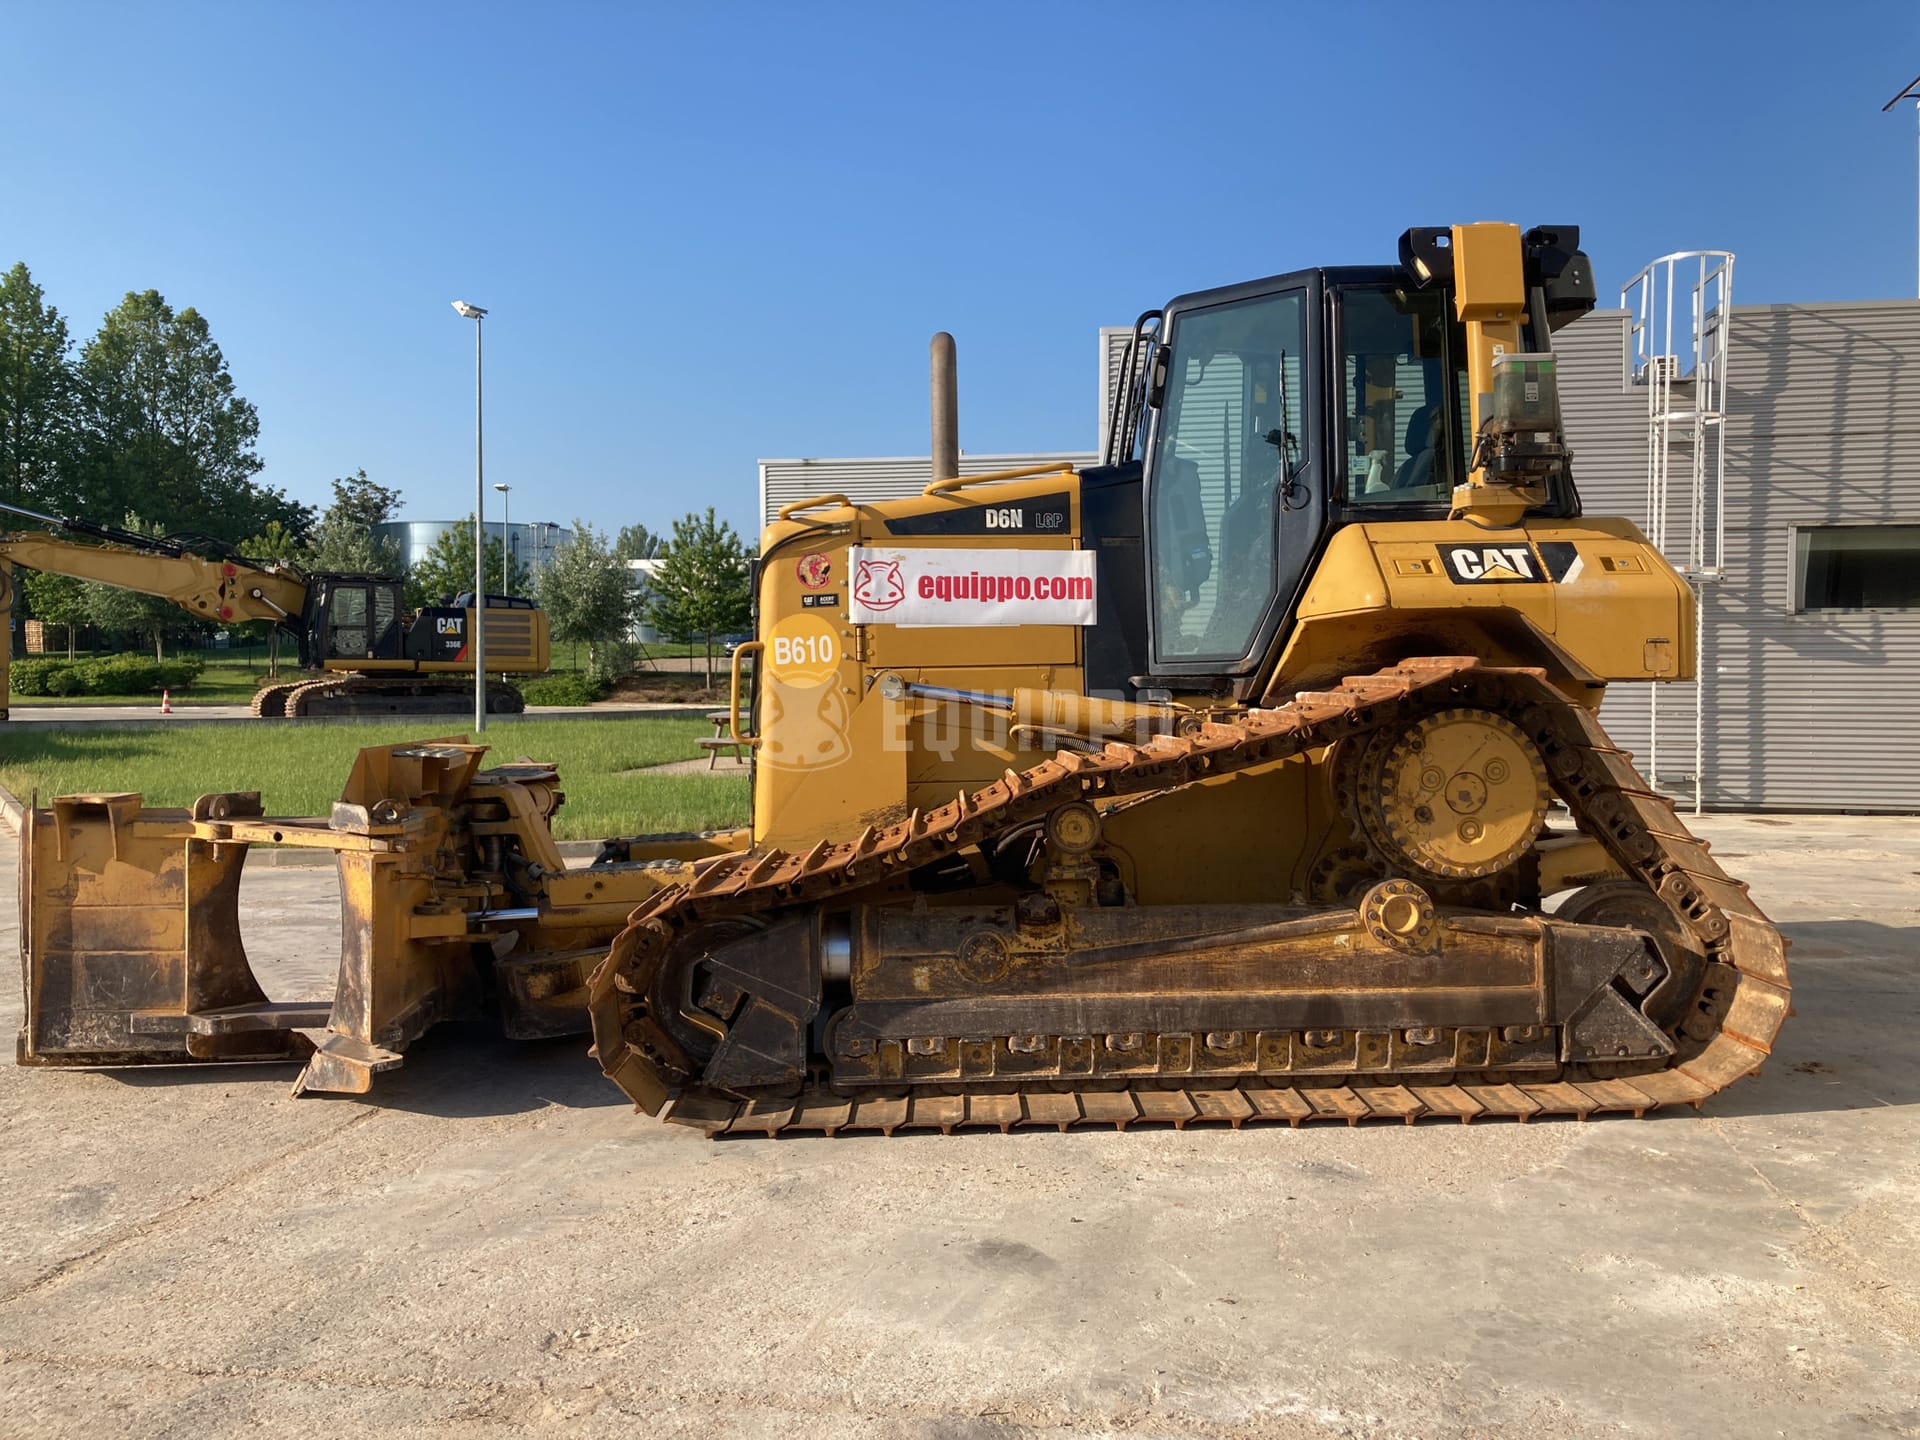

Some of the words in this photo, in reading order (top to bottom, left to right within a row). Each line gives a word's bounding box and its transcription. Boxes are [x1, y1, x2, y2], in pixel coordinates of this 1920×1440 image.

[985, 508, 1023, 528] D6N
[1035, 513, 1063, 528] LGP
[1450, 548, 1534, 580] CAT
[918, 571, 1093, 602] equippo.com
[436, 617, 463, 634] CAT
[774, 634, 833, 665] B610
